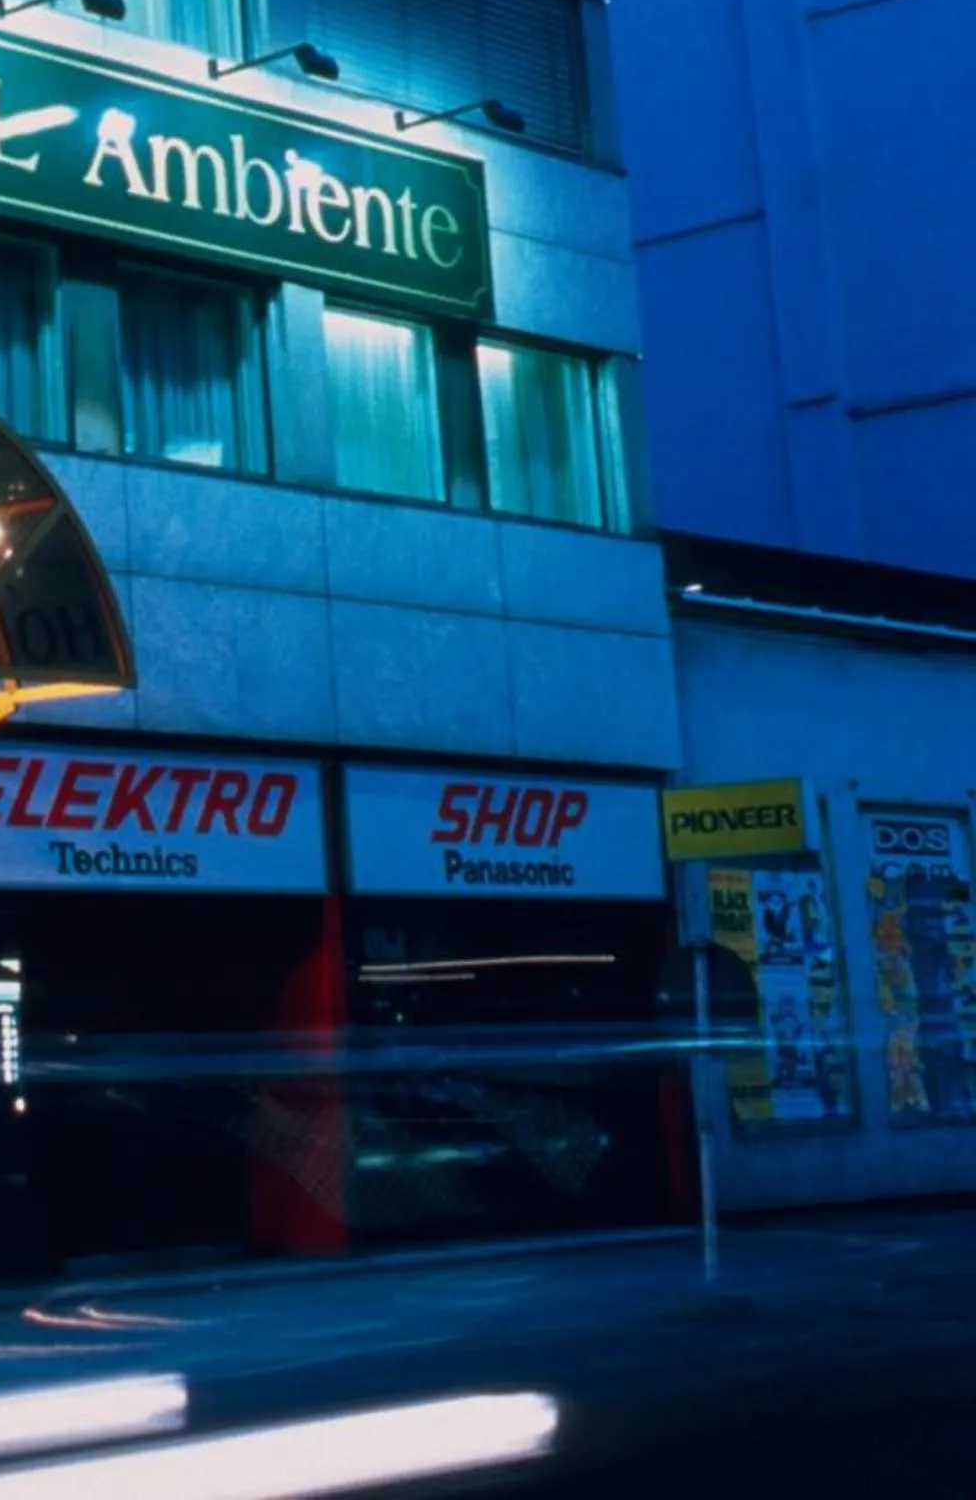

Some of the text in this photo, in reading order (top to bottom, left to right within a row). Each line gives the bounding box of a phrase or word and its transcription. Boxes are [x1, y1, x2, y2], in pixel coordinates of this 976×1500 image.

[83, 108, 463, 267] Ambiente
[432, 784, 589, 847] SHOP
[671, 803, 798, 836] PIONEER
[875, 825, 949, 851] DOS
[49, 842, 198, 878] Technics
[444, 850, 575, 888] Panasonic
